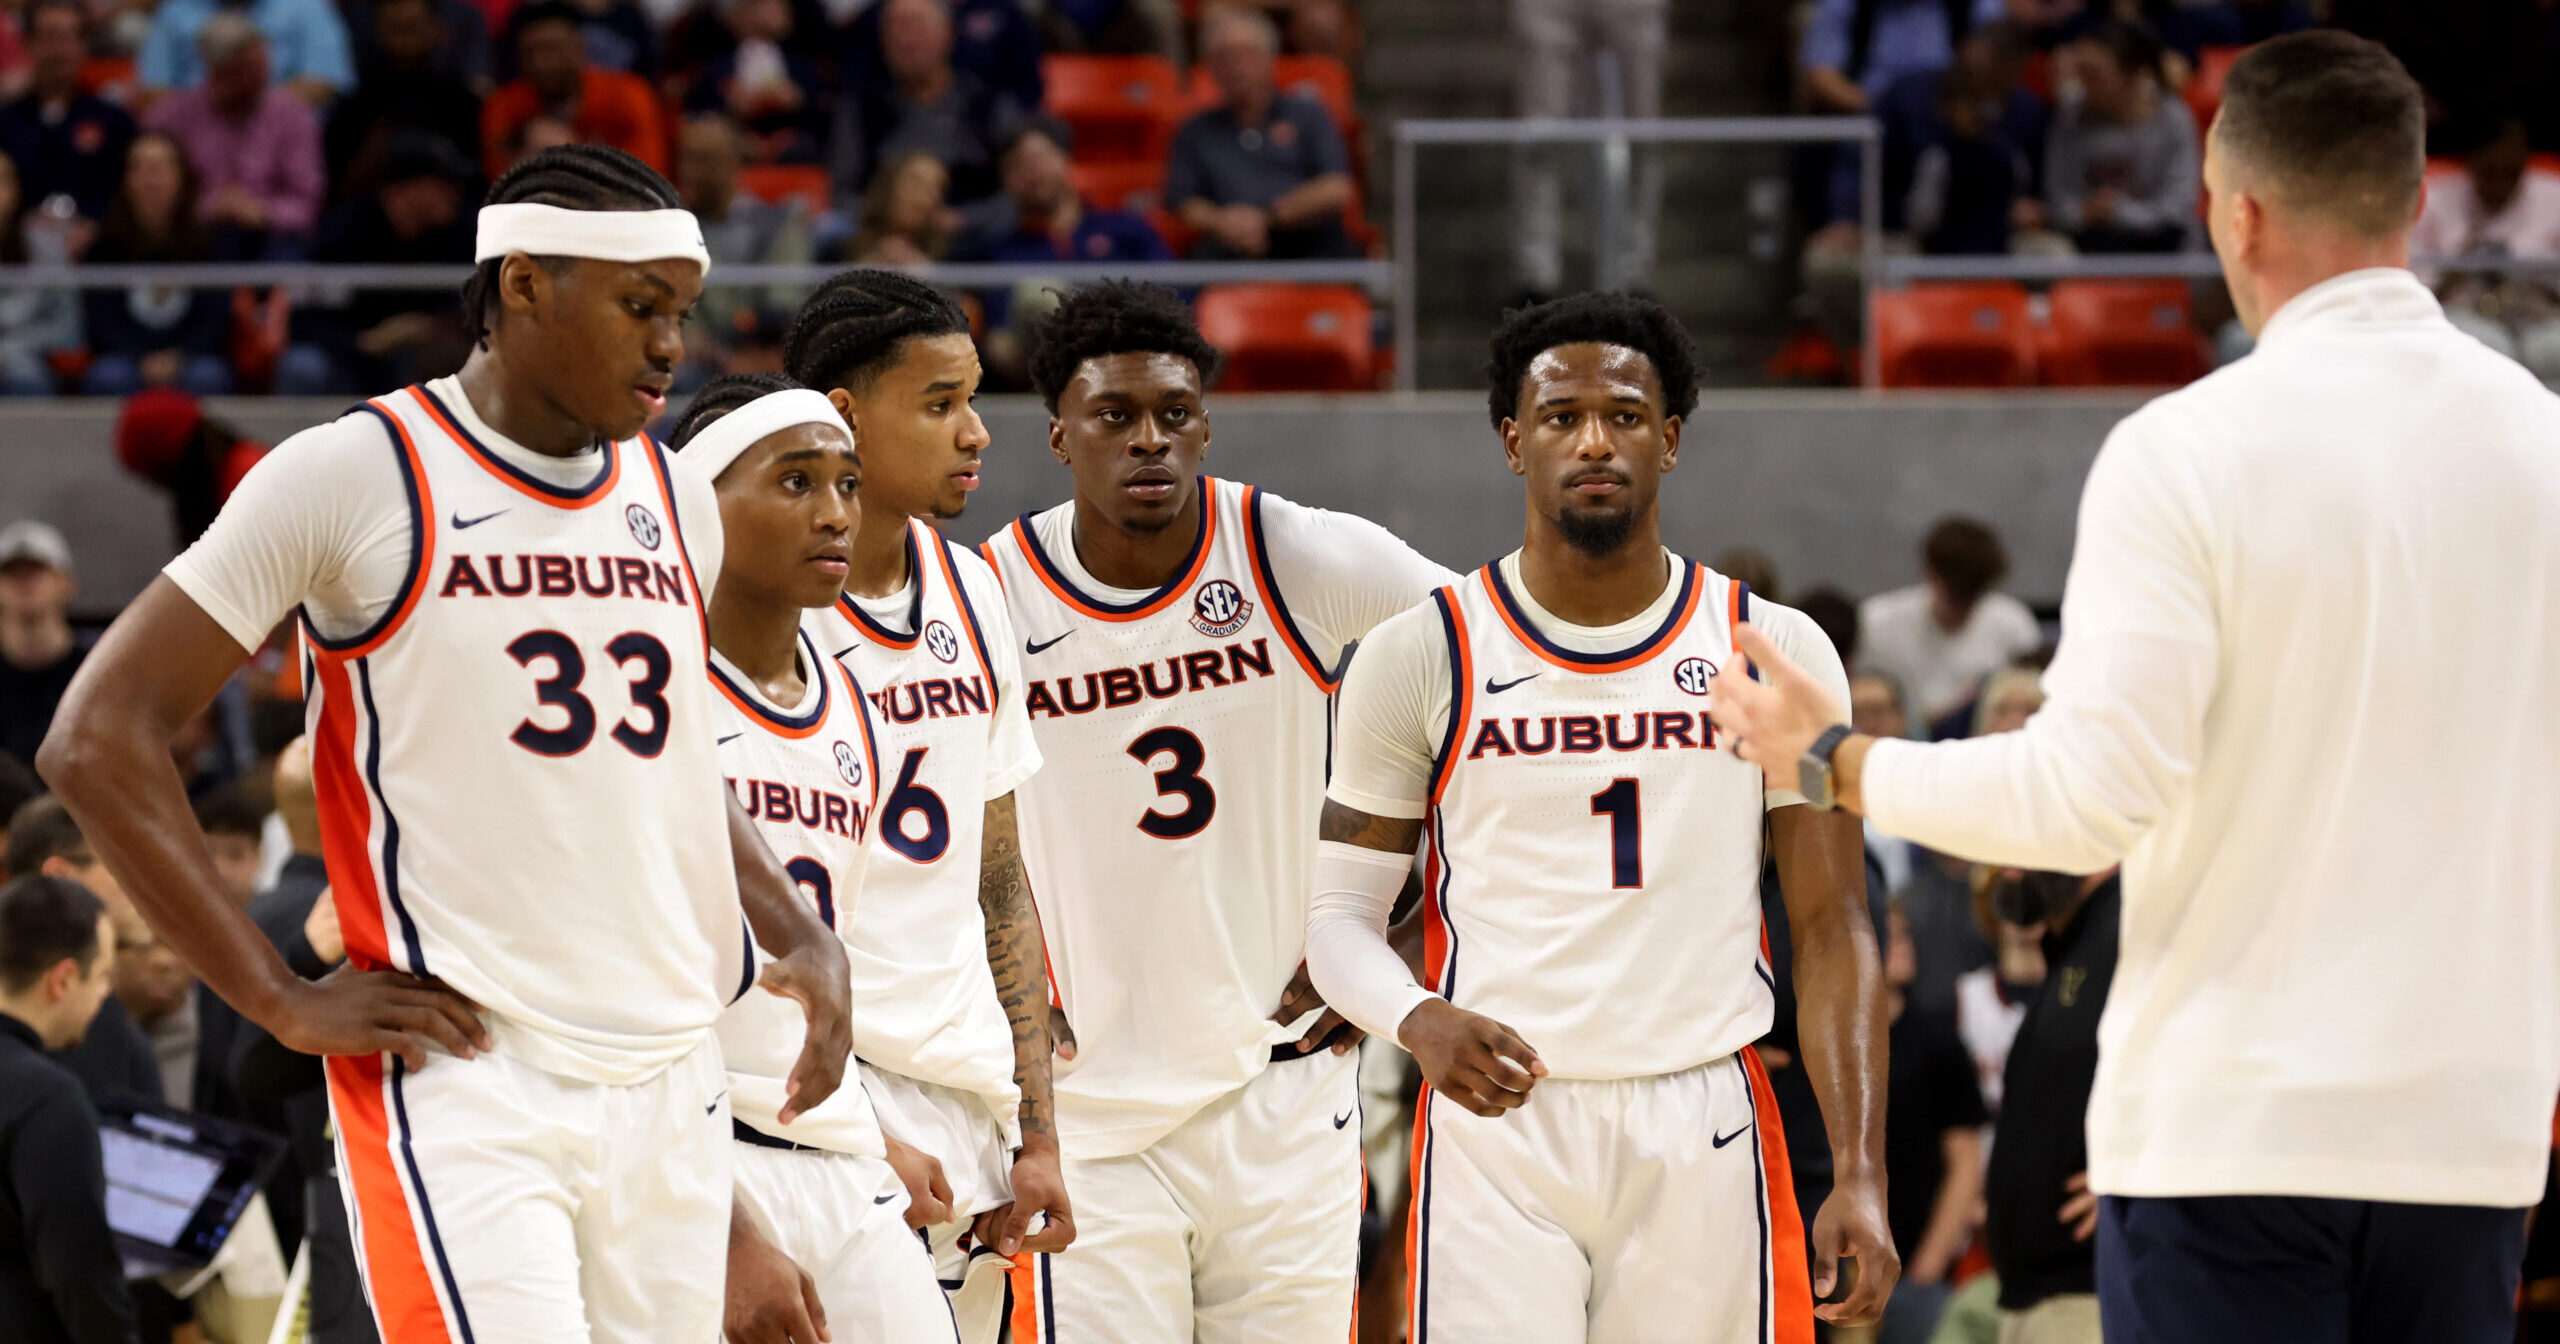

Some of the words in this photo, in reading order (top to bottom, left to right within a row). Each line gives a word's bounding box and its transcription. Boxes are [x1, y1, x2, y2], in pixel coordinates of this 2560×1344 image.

[439, 555, 688, 606] AUBURN
[1198, 582, 1240, 623] SEC
[926, 621, 957, 662] SEC
[1199, 612, 1249, 636] GRADUATE
[504, 629, 672, 760] 33
[1026, 638, 1275, 720] AUBURN
[726, 777, 870, 846] UBURN
[879, 747, 951, 864] 6
[1126, 726, 1217, 840] 3
[1591, 778, 1643, 889] 1
